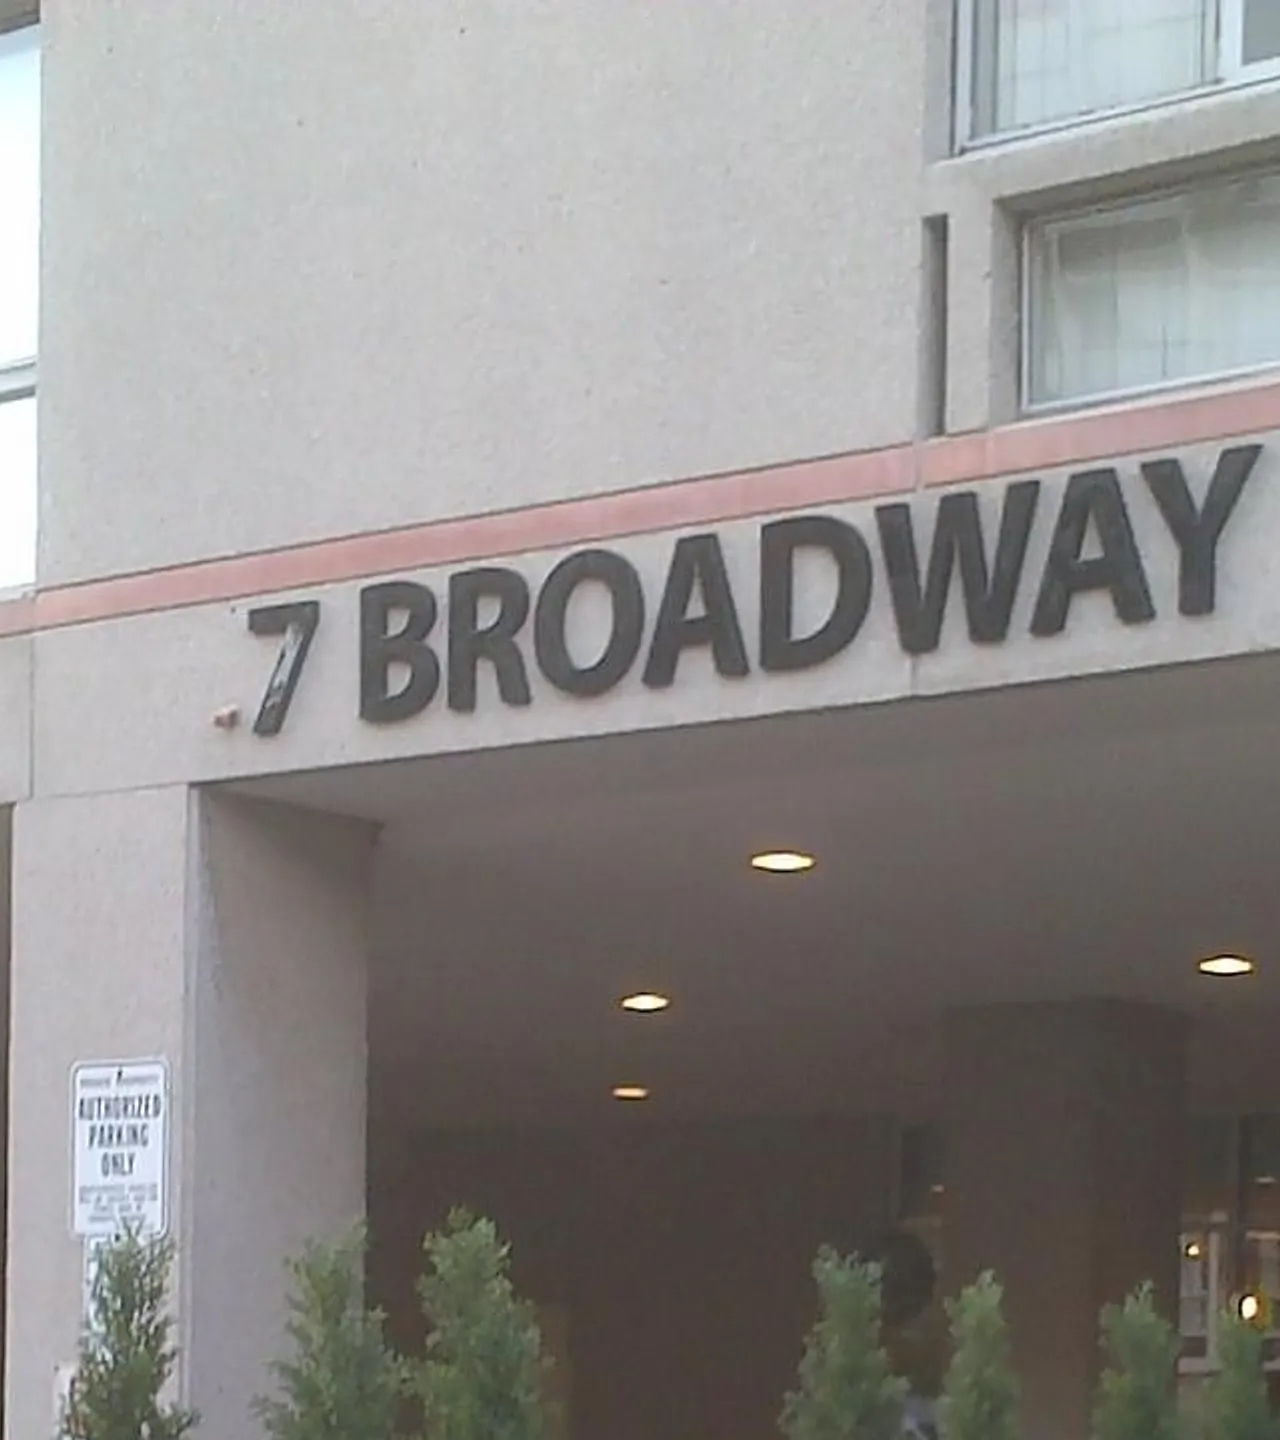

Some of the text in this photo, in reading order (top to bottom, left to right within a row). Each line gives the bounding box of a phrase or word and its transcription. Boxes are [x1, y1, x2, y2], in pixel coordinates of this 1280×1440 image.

[248, 599, 320, 737] 7
[358, 444, 1264, 723] BROADWAY
[79, 1095, 161, 1121] AUTHORIZED
[88, 1124, 149, 1148] PARKING
[101, 1152, 135, 1177] ONLY
